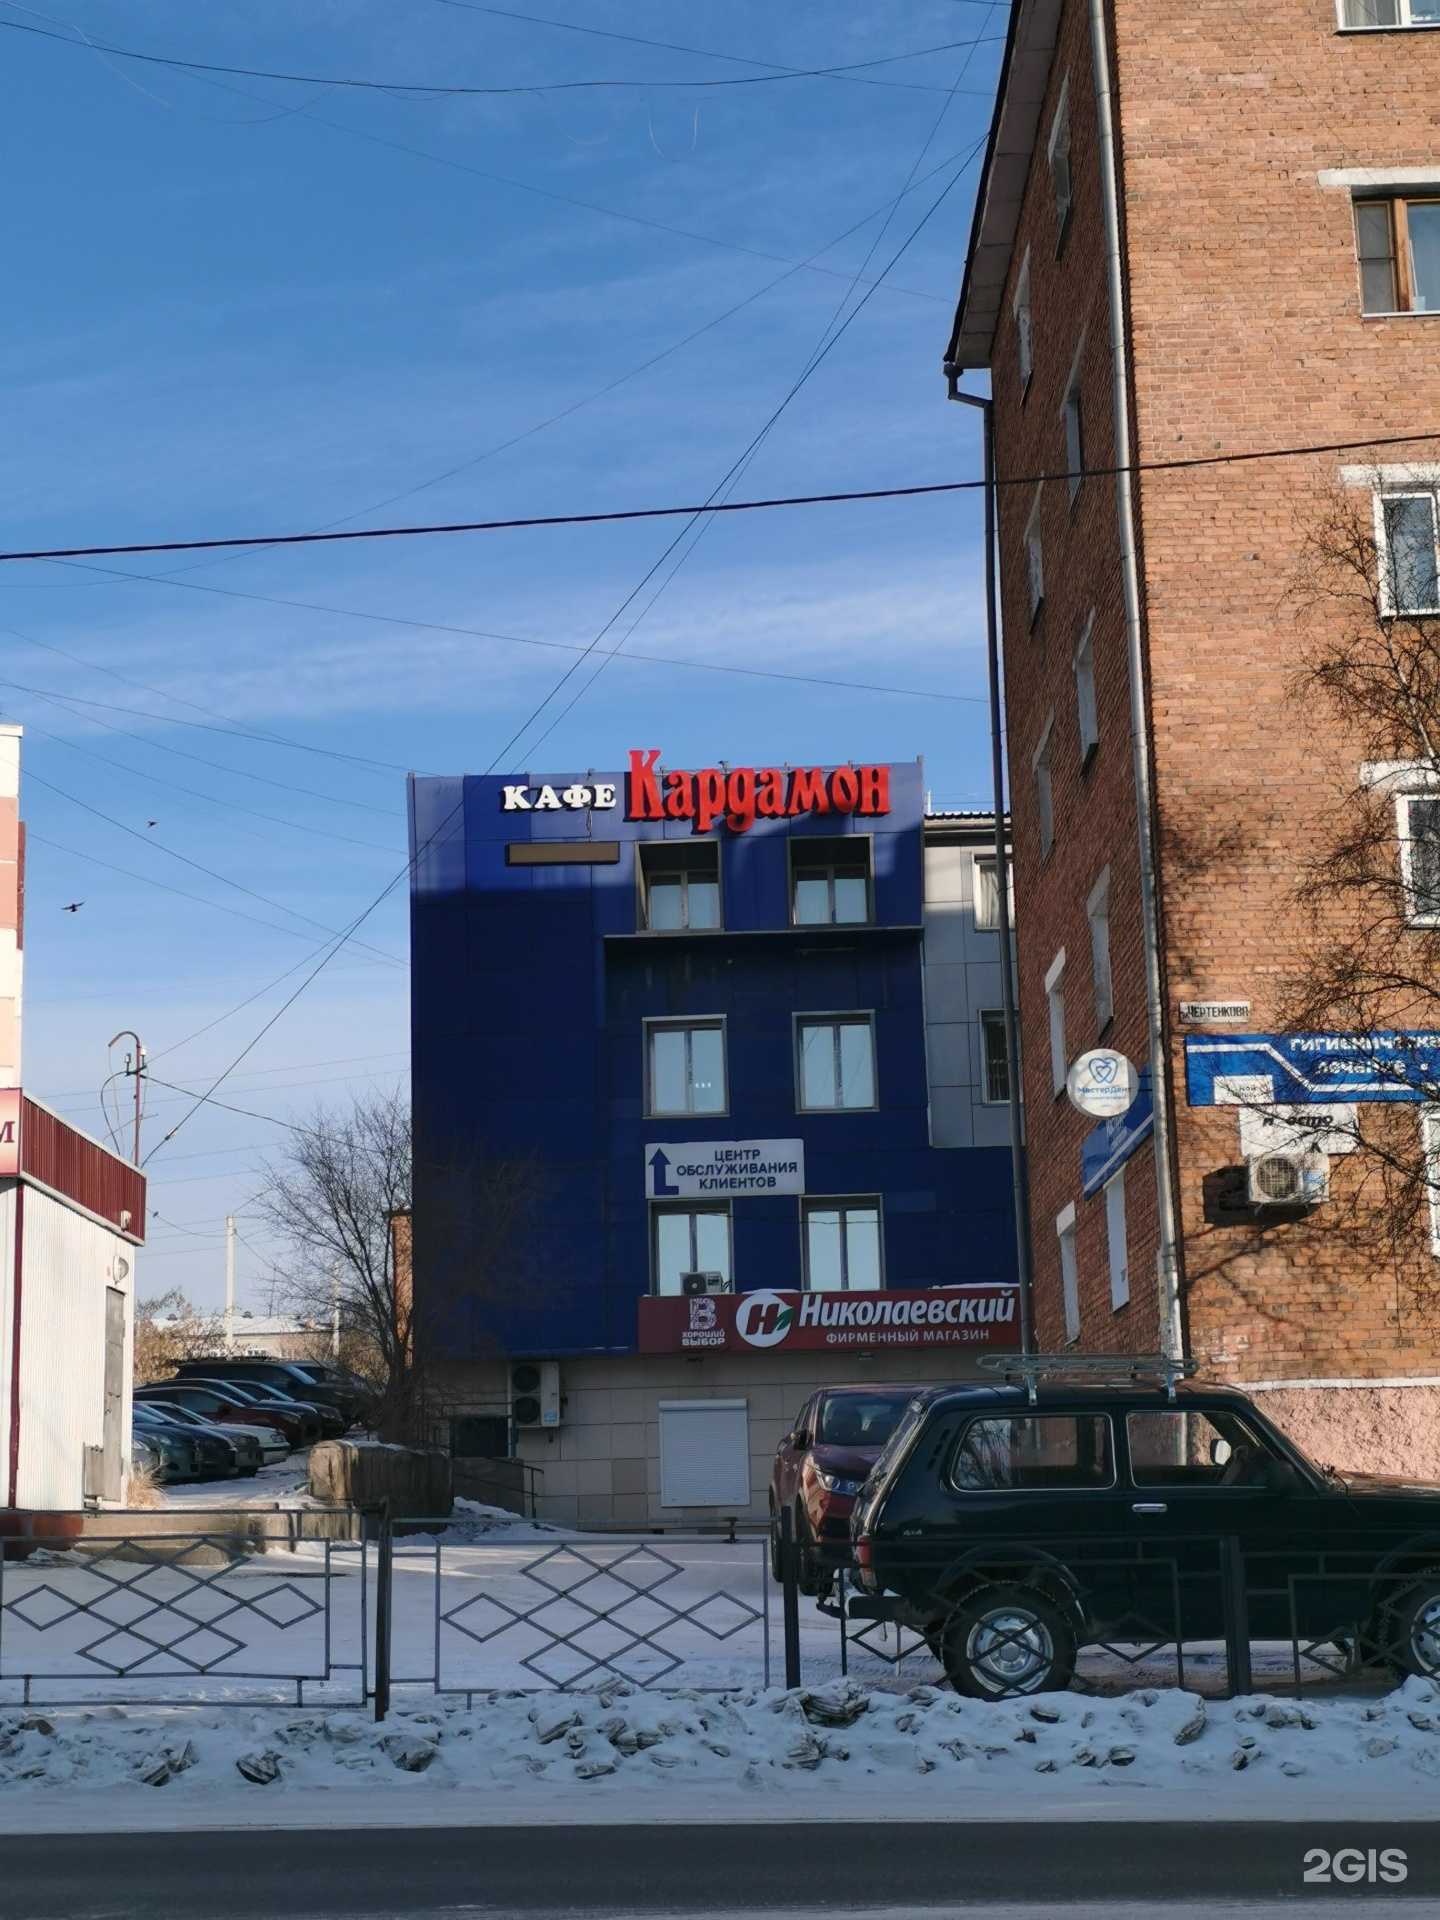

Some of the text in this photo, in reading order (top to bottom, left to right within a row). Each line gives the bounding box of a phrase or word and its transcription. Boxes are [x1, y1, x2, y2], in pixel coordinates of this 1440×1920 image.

[503, 749, 891, 832] КАФЕ Кардамон
[1187, 1004, 1249, 1018] ЧЕРТЕНКОВА
[714, 1149, 761, 1163] ЦЕНТР
[676, 1161, 798, 1177] ОБСЛУЖИВАНИЯ
[699, 1176, 777, 1190] КЛИЕНТОВ
[798, 1289, 1015, 1328] Николаевский
[682, 1337, 726, 1346] ВЫБОР
[826, 1328, 990, 1344] ФИРМЕННЫЙ МАГАЗИН
